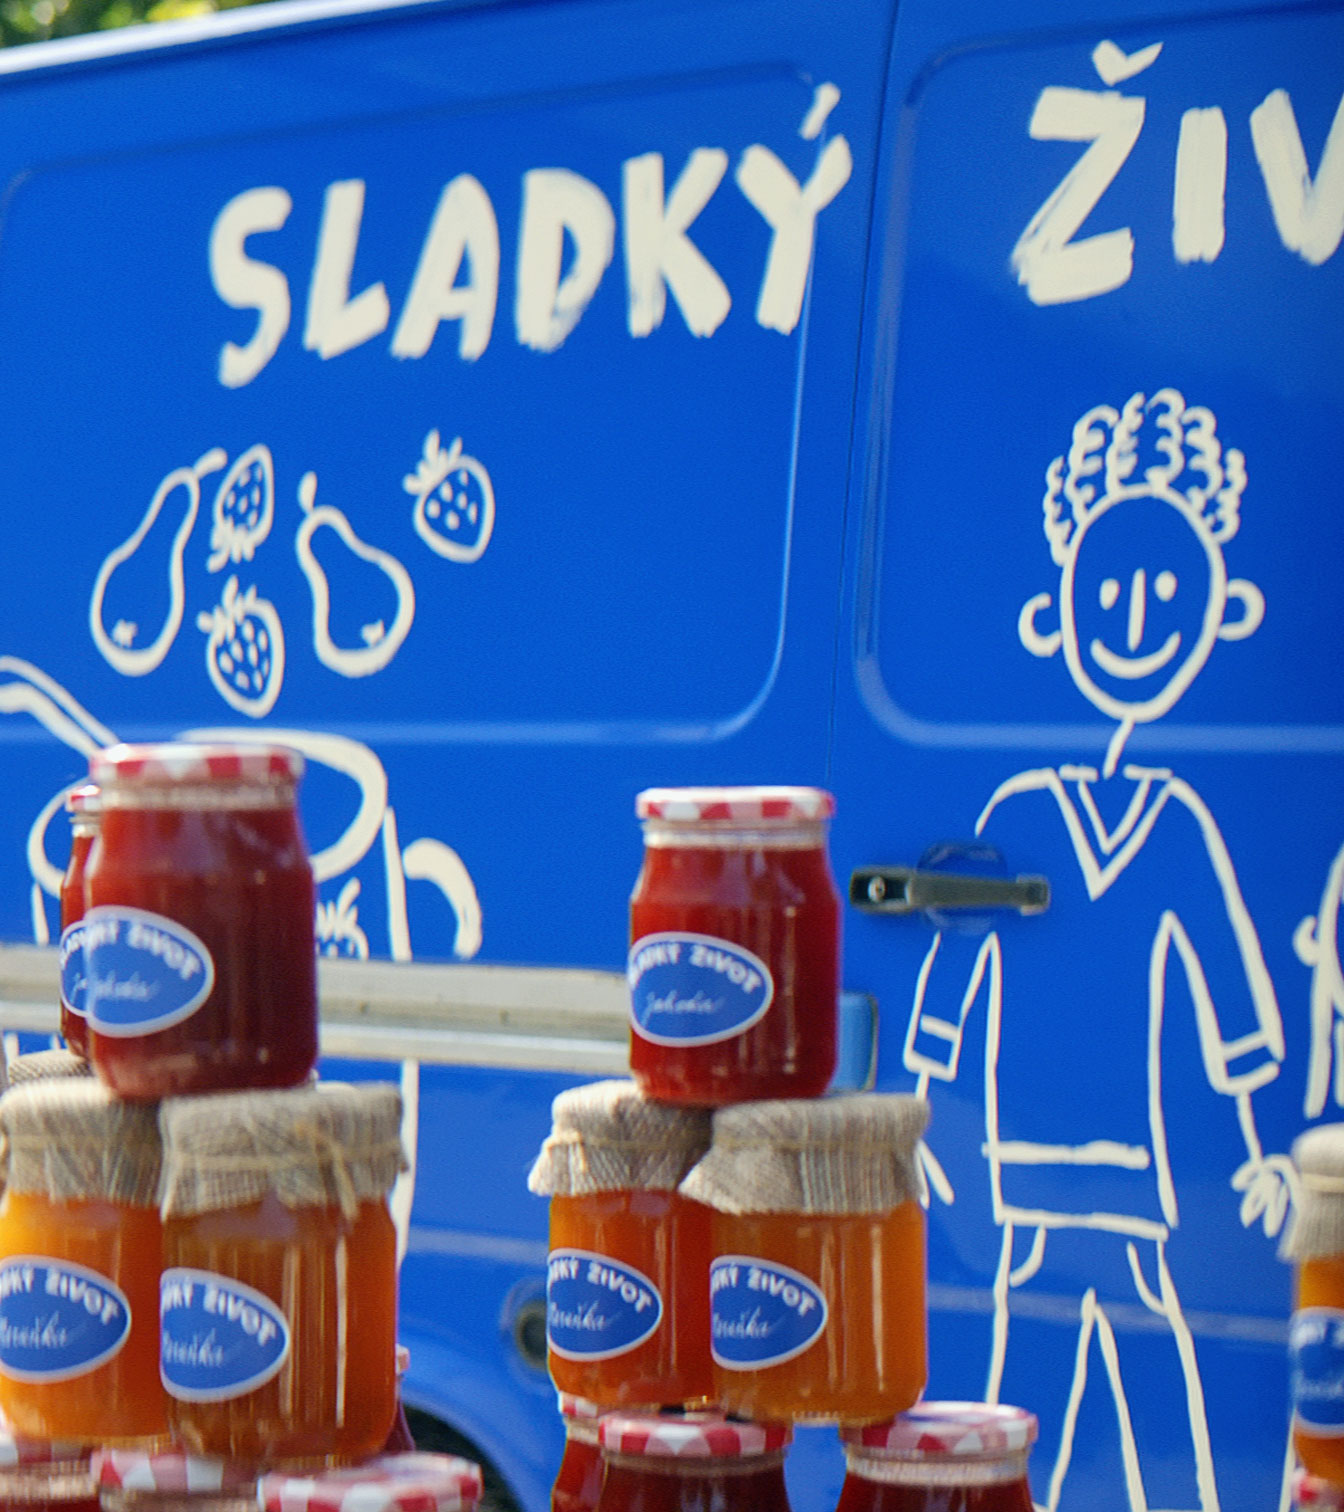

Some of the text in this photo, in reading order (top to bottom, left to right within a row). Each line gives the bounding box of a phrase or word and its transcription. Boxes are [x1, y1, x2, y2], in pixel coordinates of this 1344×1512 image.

[209, 83, 853, 389] SLADKÝ
[689, 942, 762, 993] ŽIVOT
[45, 1265, 120, 1326] ŽIVOT
[203, 1282, 276, 1347] ŽIVOT
[587, 1261, 652, 1313] ŽIVOT
[747, 1264, 816, 1317] ŽIVOT
